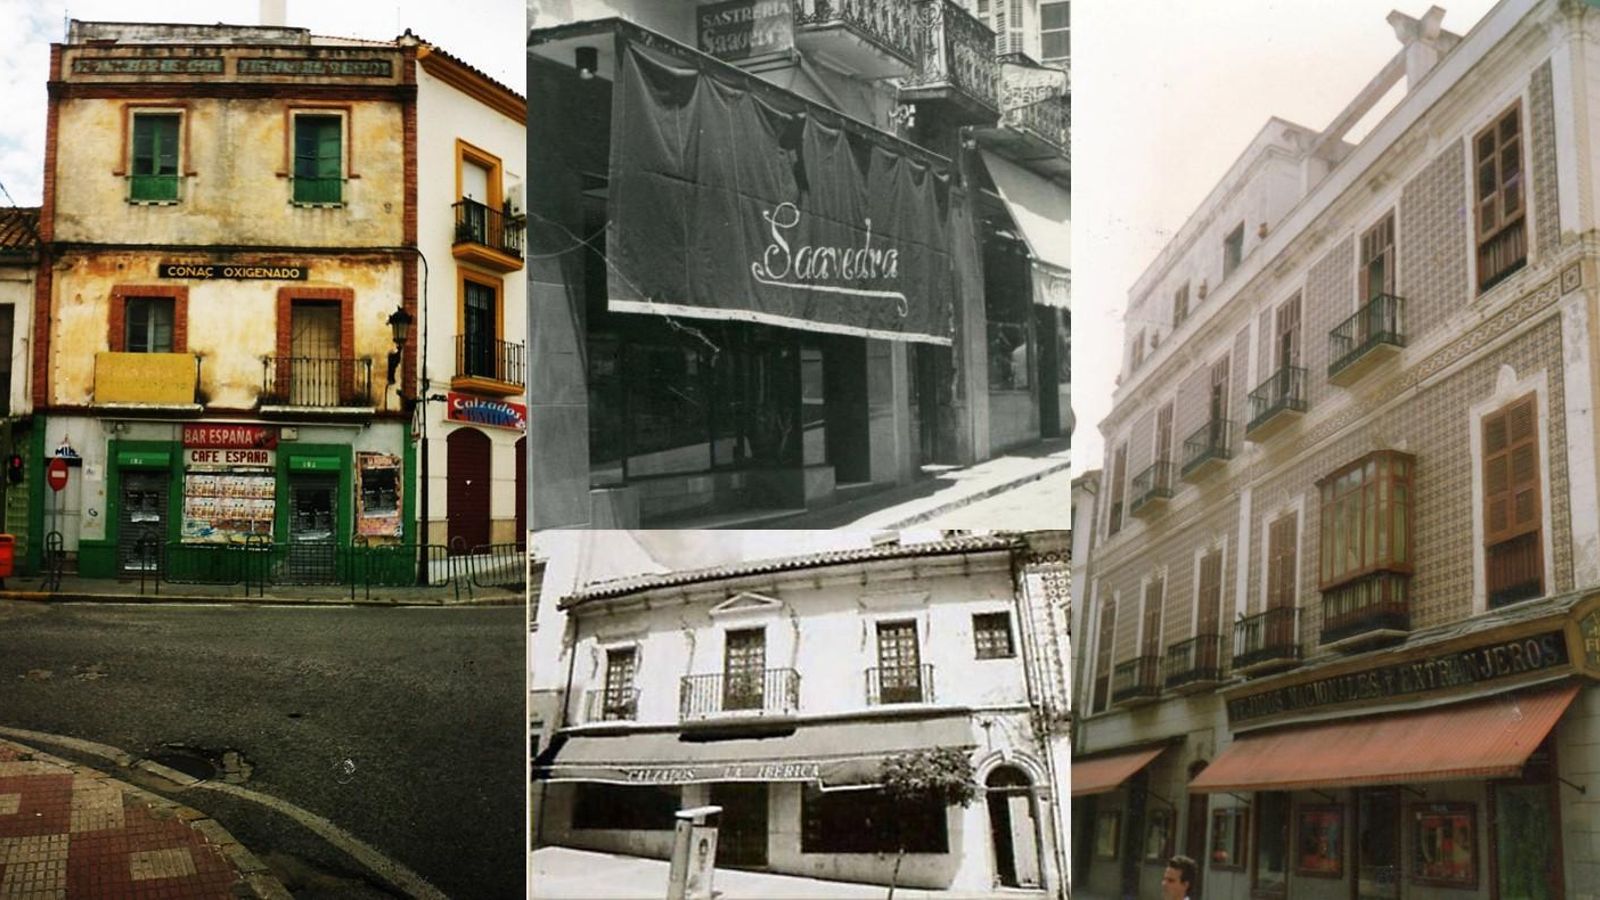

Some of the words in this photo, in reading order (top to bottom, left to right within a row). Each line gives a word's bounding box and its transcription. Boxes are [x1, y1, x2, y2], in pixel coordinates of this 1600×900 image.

[702, 1, 790, 28] SASTRERIA
[761, 202, 899, 280] Saavedra
[223, 267, 300, 279] OXIGENADO
[453, 397, 522, 419] Calzados
[184, 428, 206, 444] BAR
[209, 426, 253, 444] ESPAÑA
[191, 450, 219, 462] CAFE
[1401, 637, 1558, 693] EXTRANJEROS
